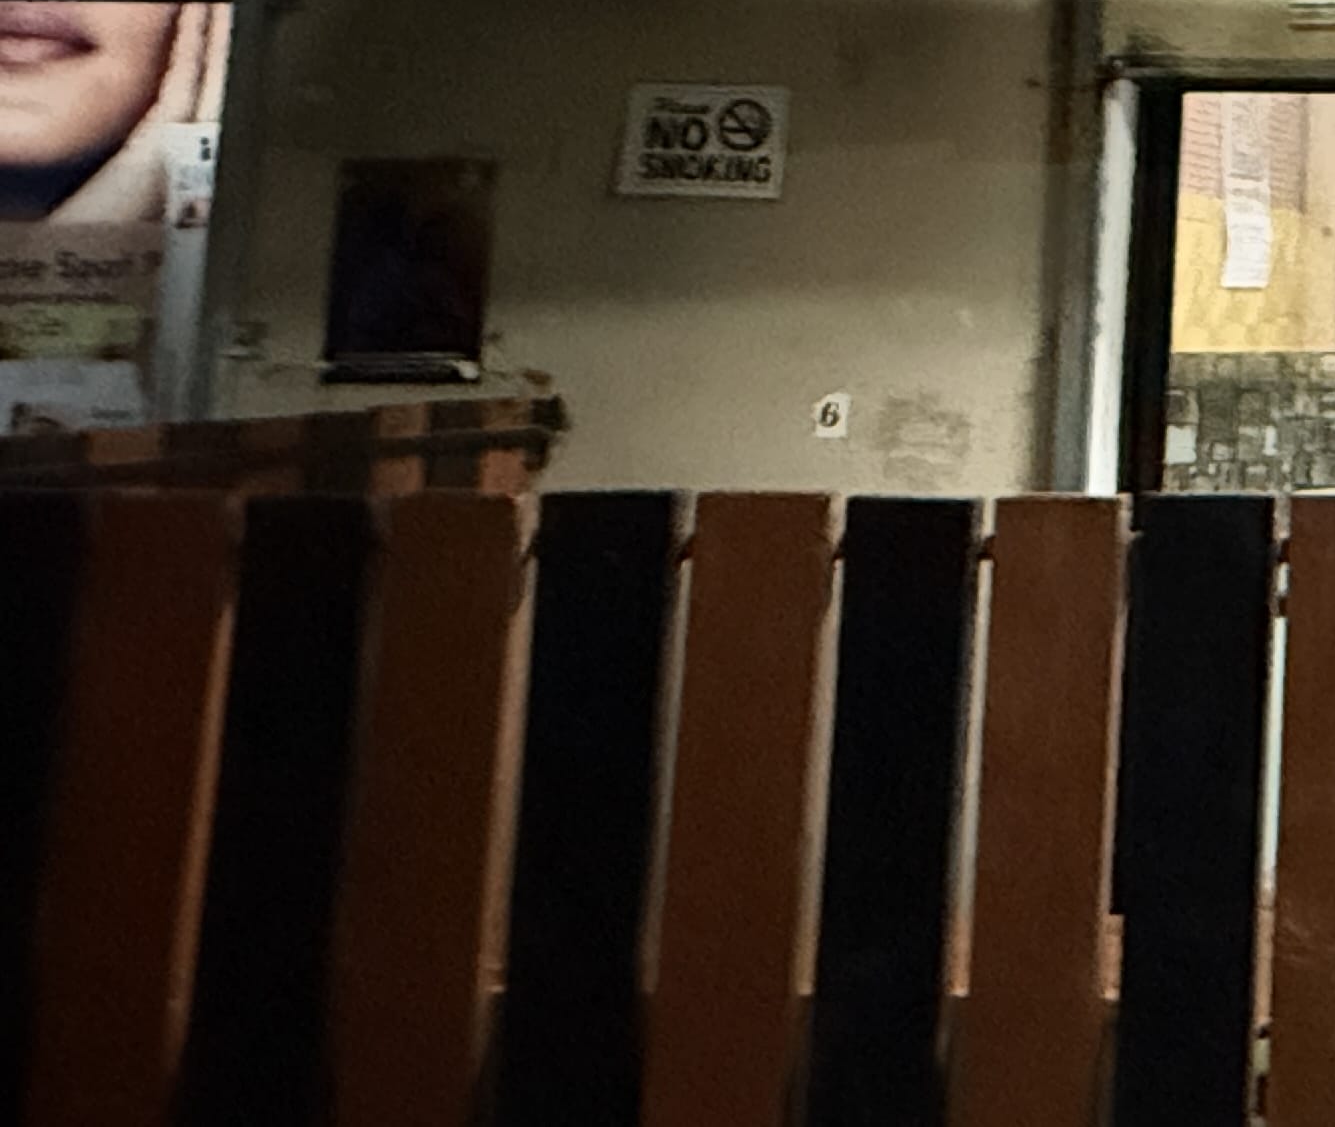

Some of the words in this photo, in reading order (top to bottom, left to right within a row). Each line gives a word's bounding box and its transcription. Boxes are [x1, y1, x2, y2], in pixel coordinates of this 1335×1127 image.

[646, 117, 707, 151] NO
[639, 152, 772, 183] SMOKING
[820, 401, 841, 427] 6
